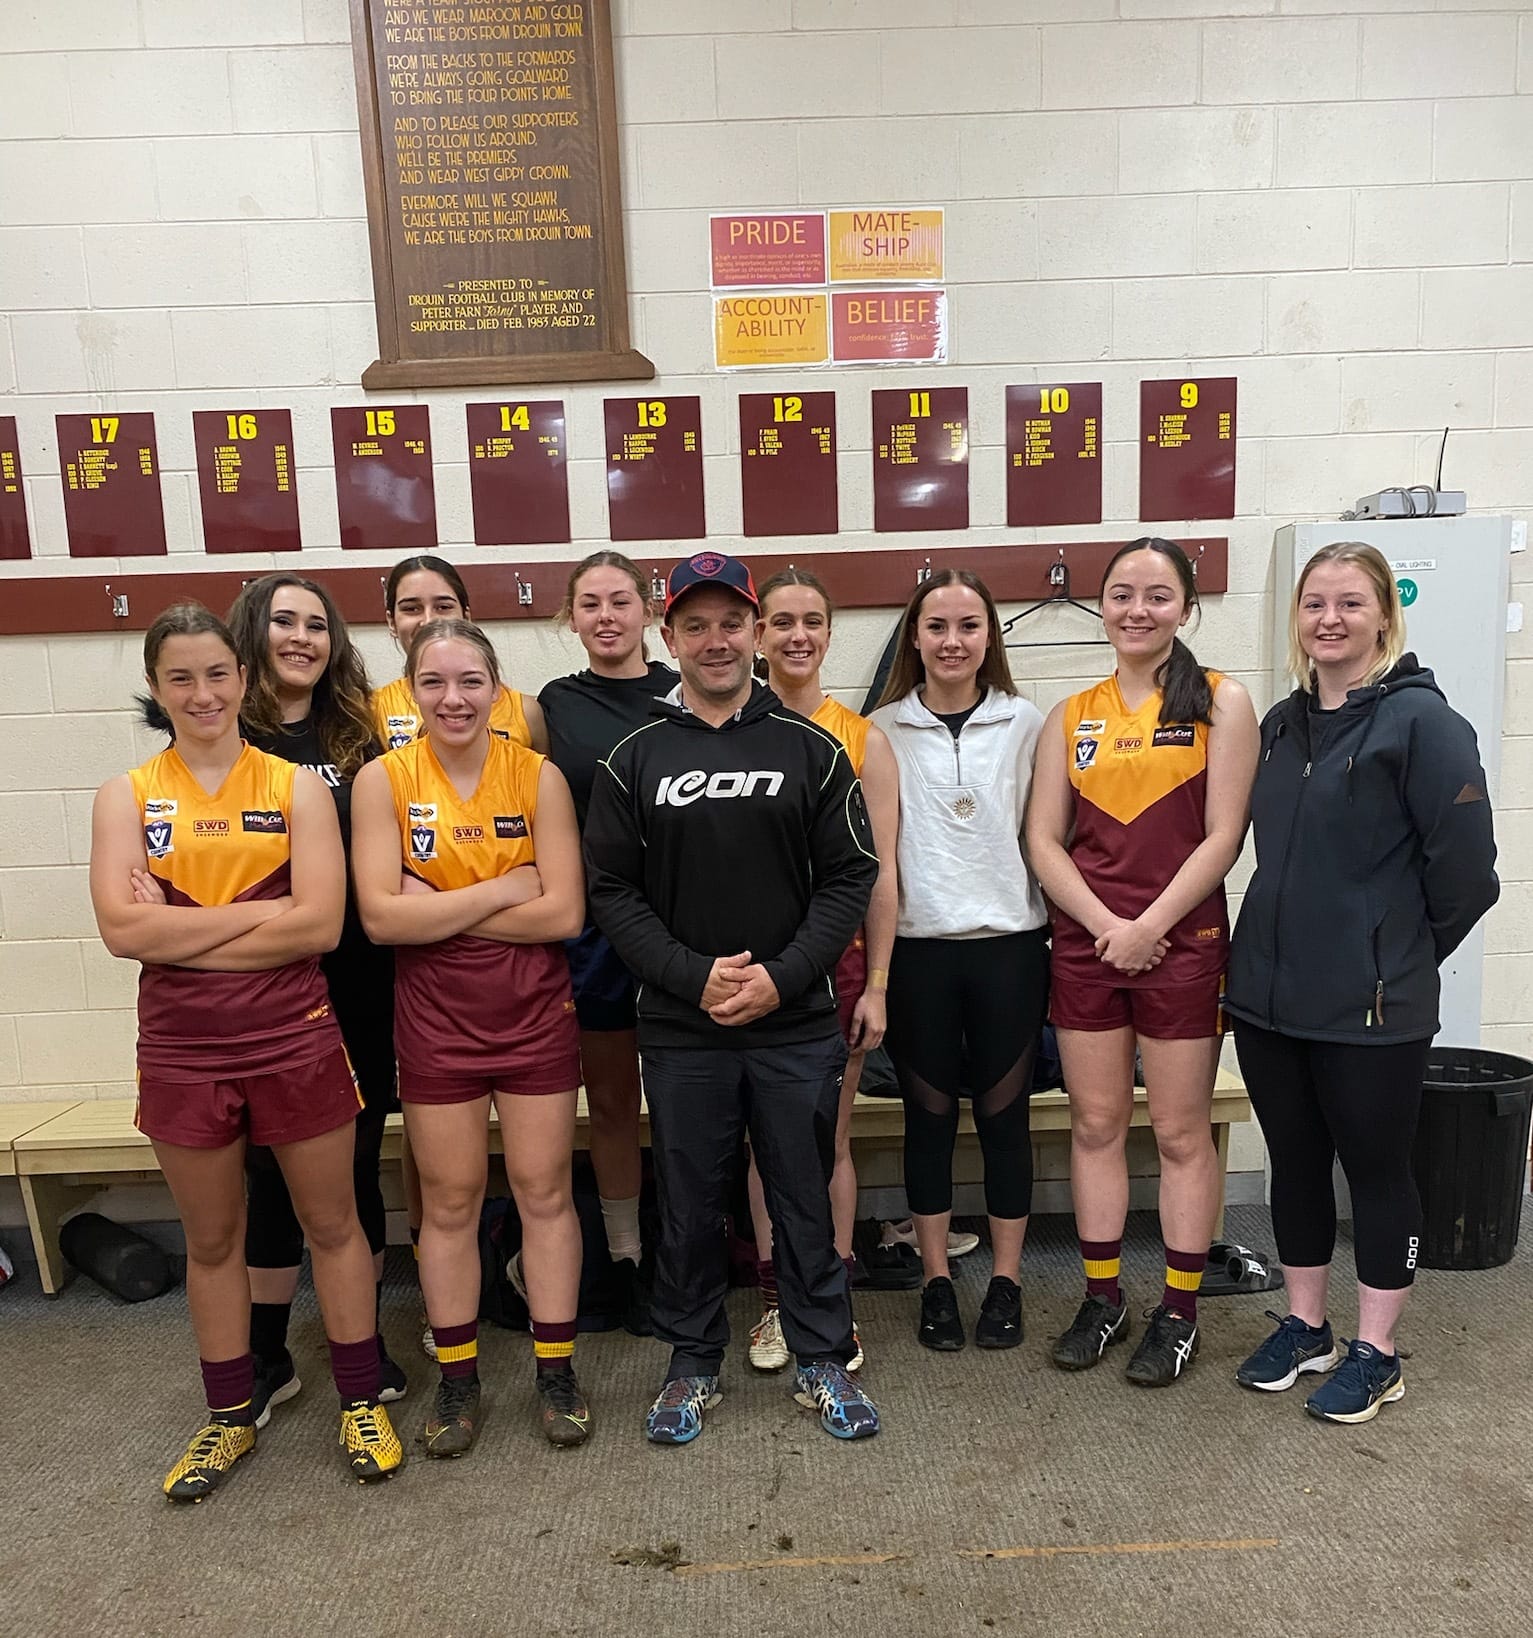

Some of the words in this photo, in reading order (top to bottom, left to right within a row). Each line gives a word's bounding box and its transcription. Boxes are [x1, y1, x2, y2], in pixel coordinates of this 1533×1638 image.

[384, 9, 409, 25] AND
[411, 9, 428, 24] WE
[432, 8, 464, 23] WEAR
[469, 7, 520, 22] MAROON
[524, 6, 547, 20] AND
[384, 28, 401, 42] WE
[403, 28, 425, 42] ARE
[427, 27, 445, 41] THE
[448, 26, 477, 41] BOYS
[479, 25, 510, 39] FROM
[512, 24, 550, 38] DROUIN
[386, 55, 418, 70] FROM
[420, 54, 438, 69] THE
[441, 53, 476, 68] BACKS
[479, 53, 493, 66] TO
[496, 52, 513, 66] THE
[517, 50, 575, 66] FORWARDS
[423, 71, 463, 87] ALWAYS
[466, 70, 502, 85] GOING
[506, 68, 568, 84] GOALWARD
[390, 91, 406, 105] TO
[409, 90, 442, 104] BRING
[444, 89, 463, 103] THE
[467, 88, 497, 102] FOUR
[500, 87, 538, 101] POINTS
[394, 117, 418, 131] AND
[421, 116, 436, 130] TO
[439, 115, 479, 130] PLEASE
[483, 114, 507, 128] OUR
[511, 112, 578, 127] SUPPORTERS
[394, 135, 422, 149] WHO
[426, 133, 469, 148] FOLLOW
[473, 133, 486, 146] US
[427, 152, 441, 166] BE
[445, 151, 463, 165] THE
[466, 150, 517, 164] PREMIERS
[399, 170, 423, 184] AND
[427, 169, 459, 183] WEAR
[463, 168, 489, 182] WEST
[493, 167, 524, 181] GIPPY
[400, 194, 458, 210] EVERMORE
[463, 193, 488, 208] WILL
[491, 193, 507, 206] WE
[511, 191, 557, 207] SQUAWK
[472, 211, 490, 225] THE
[493, 210, 529, 224] MIGHTY
[853, 213, 920, 232] MATE-
[403, 231, 420, 244] WE
[423, 230, 445, 244] ARE
[447, 229, 466, 244] THE
[468, 229, 494, 243] BOYS
[496, 227, 523, 241] FROM
[525, 226, 560, 240] DROUIN
[730, 220, 806, 245] PRIDE
[863, 237, 909, 256] SHIP
[458, 279, 515, 291] PRESENTED
[518, 279, 532, 288] TO
[408, 294, 444, 305] DROUIN
[448, 292, 497, 304] FOOTBALL
[500, 291, 525, 302] CLUB
[528, 291, 537, 301] IN
[540, 289, 579, 301] MEMORY
[581, 289, 594, 299] OF
[421, 307, 452, 318] PETER
[454, 306, 481, 317] FARN
[520, 303, 558, 315] PLAYER
[560, 302, 583, 313] AND
[721, 298, 822, 317] ACCOUNT-
[847, 300, 931, 324] BELIEF
[476, 318, 499, 329] DIED
[551, 315, 579, 326] AGED
[582, 315, 595, 325] 22
[736, 318, 806, 338] ABILITY
[909, 392, 931, 417] 11
[1040, 388, 1069, 413] 10
[1180, 382, 1199, 408] 9
[500, 405, 530, 431] 14
[637, 401, 667, 427] 13
[773, 396, 803, 422] 12
[91, 418, 119, 443] 17
[227, 414, 257, 440] 16
[365, 411, 395, 436] 15
[1117, 739, 1141, 748] SWD
[196, 821, 227, 830] SWD
[455, 828, 482, 838] SWD
